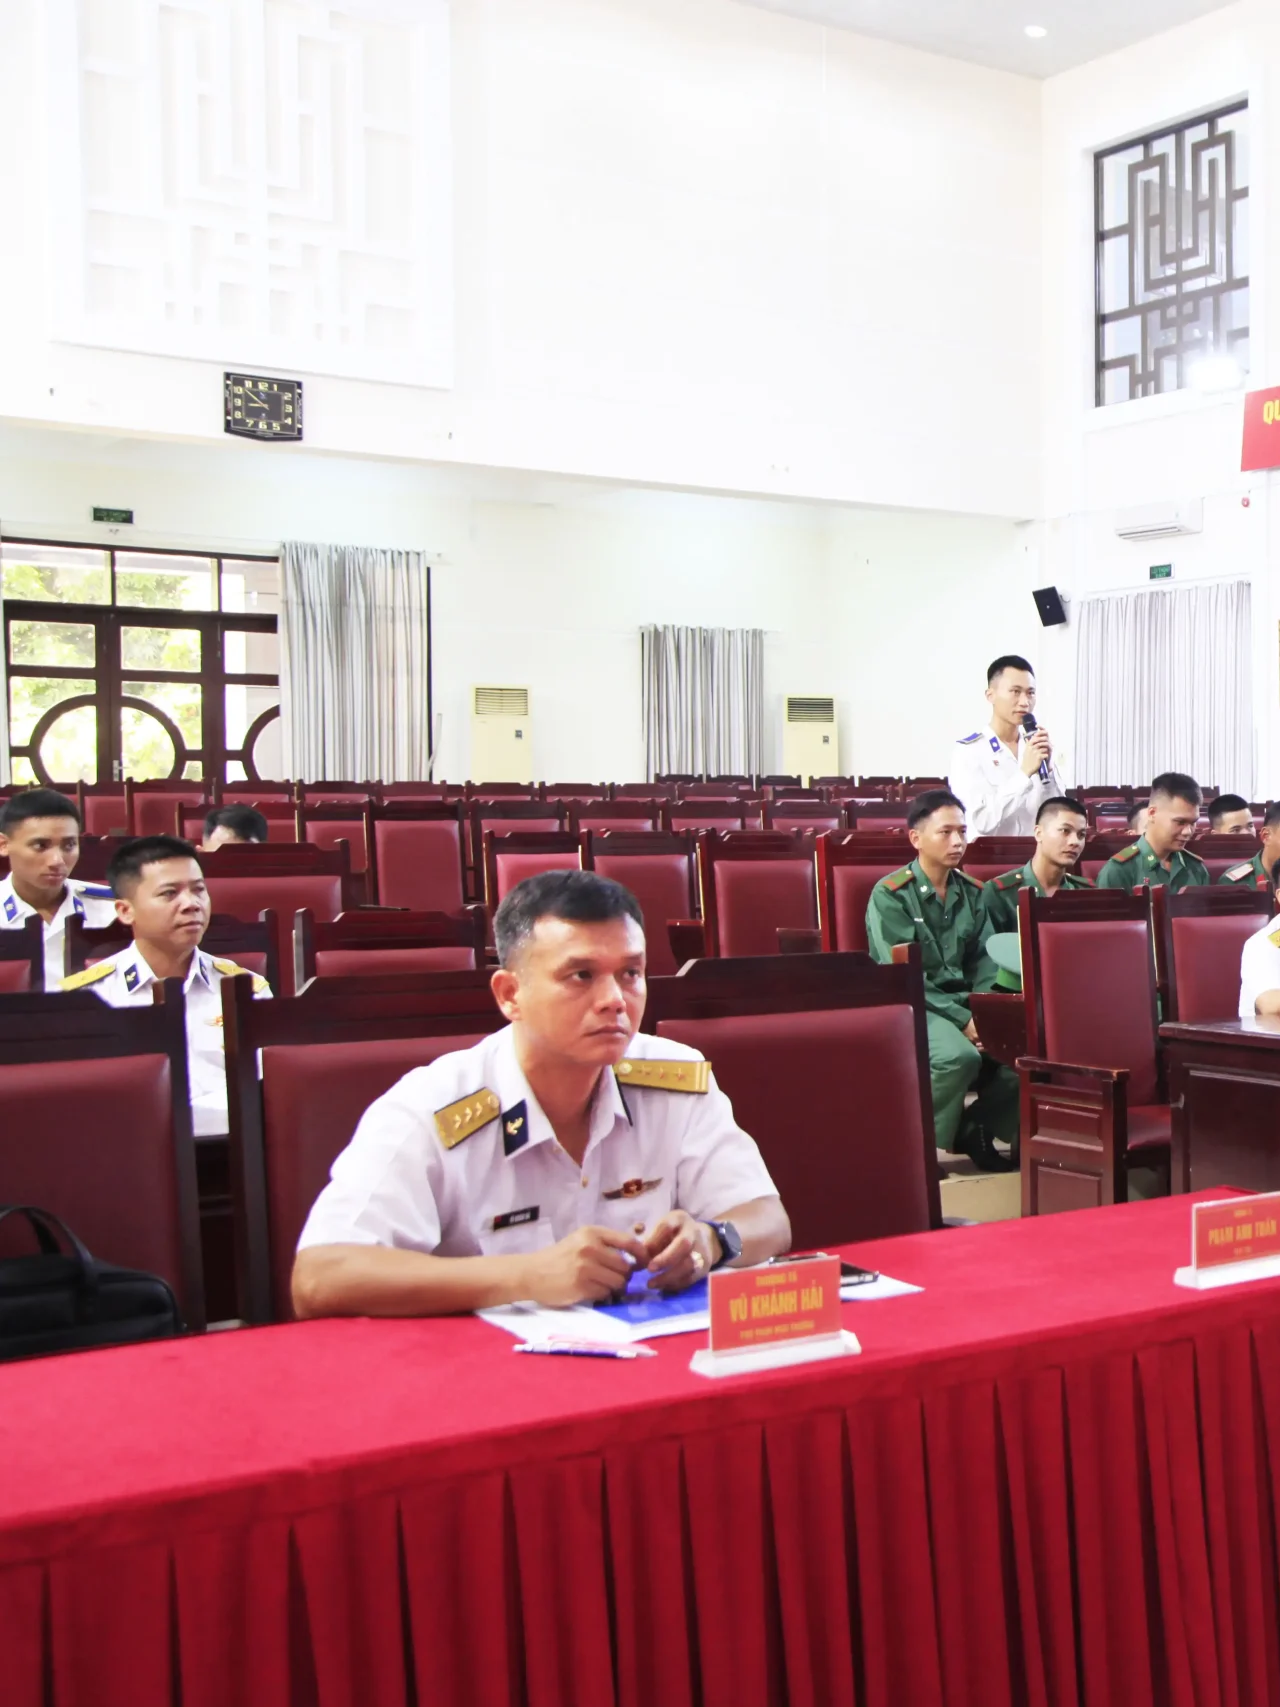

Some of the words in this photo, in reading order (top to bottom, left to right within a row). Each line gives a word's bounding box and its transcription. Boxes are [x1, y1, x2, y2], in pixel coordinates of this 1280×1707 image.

[258, 382, 268, 392] 12
[283, 392, 292, 401] 2
[234, 398, 242, 406] 9
[284, 404, 292, 413] 3
[246, 419, 254, 427] 7
[258, 421, 267, 429] 6
[272, 422, 280, 431] 5
[751, 1287, 797, 1319] KHÁNH
